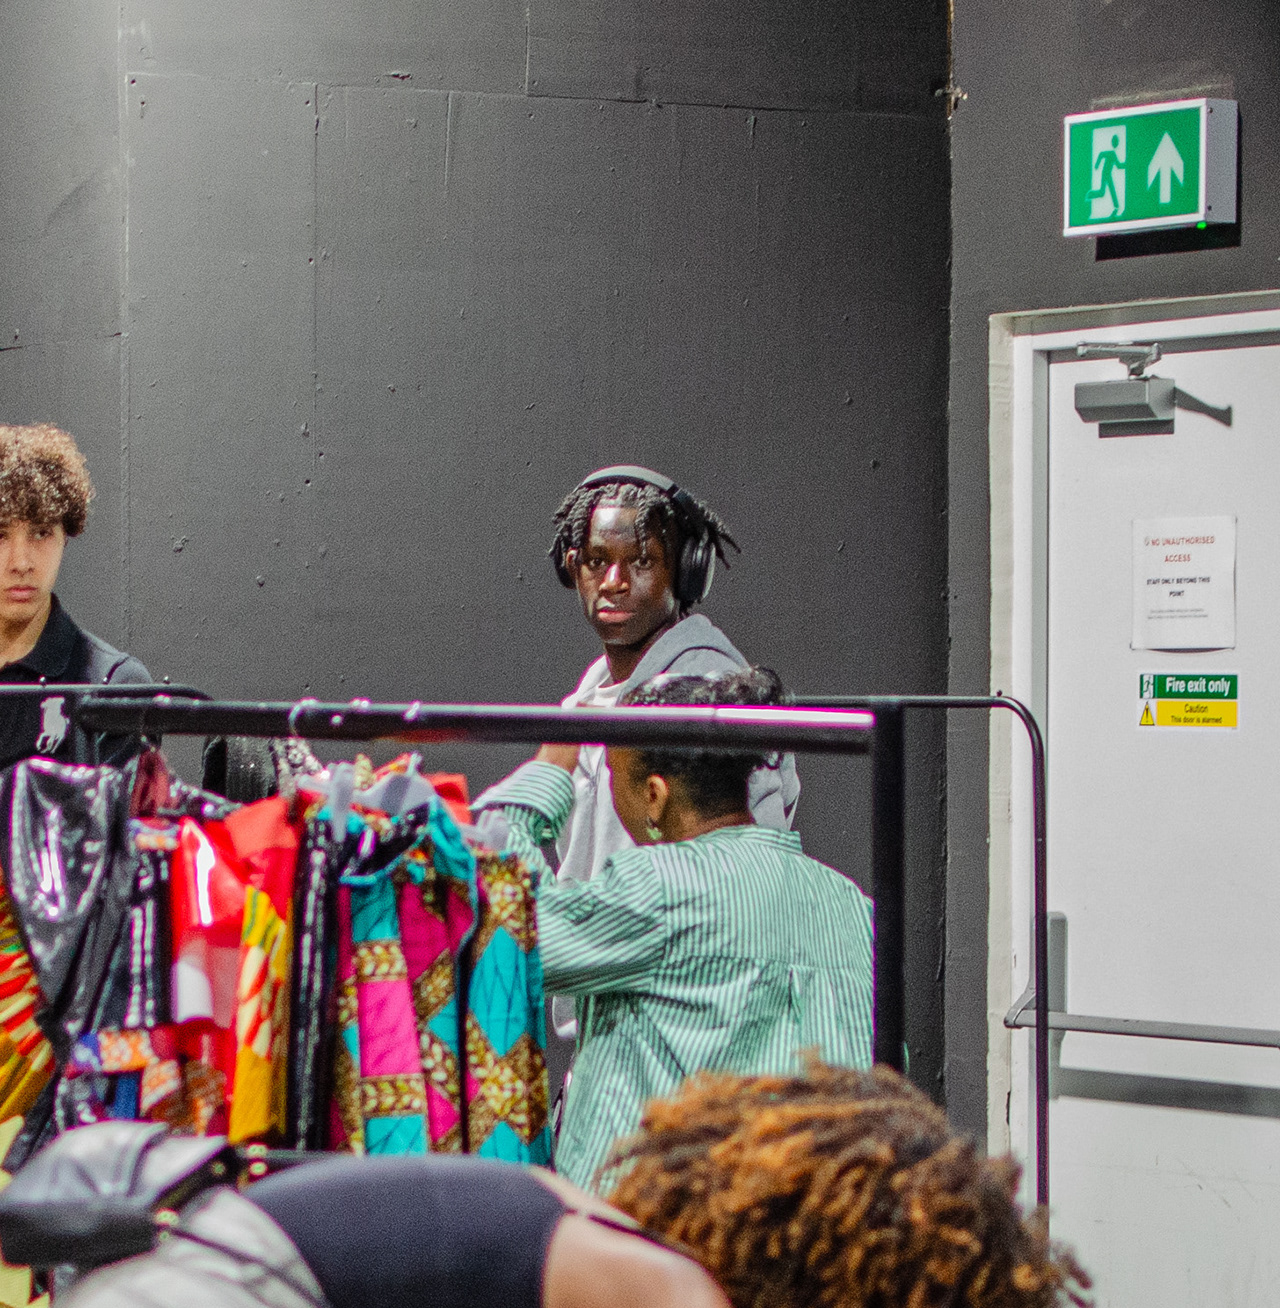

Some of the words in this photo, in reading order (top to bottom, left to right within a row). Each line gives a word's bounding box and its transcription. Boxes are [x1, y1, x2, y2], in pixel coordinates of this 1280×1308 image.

[1151, 538, 1160, 546] NO
[1162, 535, 1215, 546] UNAUTHORISED
[1165, 554, 1191, 562] ACCESS
[1166, 676, 1185, 692] Fire
[1187, 676, 1206, 692] exit
[1208, 677, 1230, 697] only
[1184, 703, 1208, 713] Caution
[1171, 715, 1181, 723] This
[1183, 715, 1194, 723] door
[1202, 716, 1223, 724] alarmed
